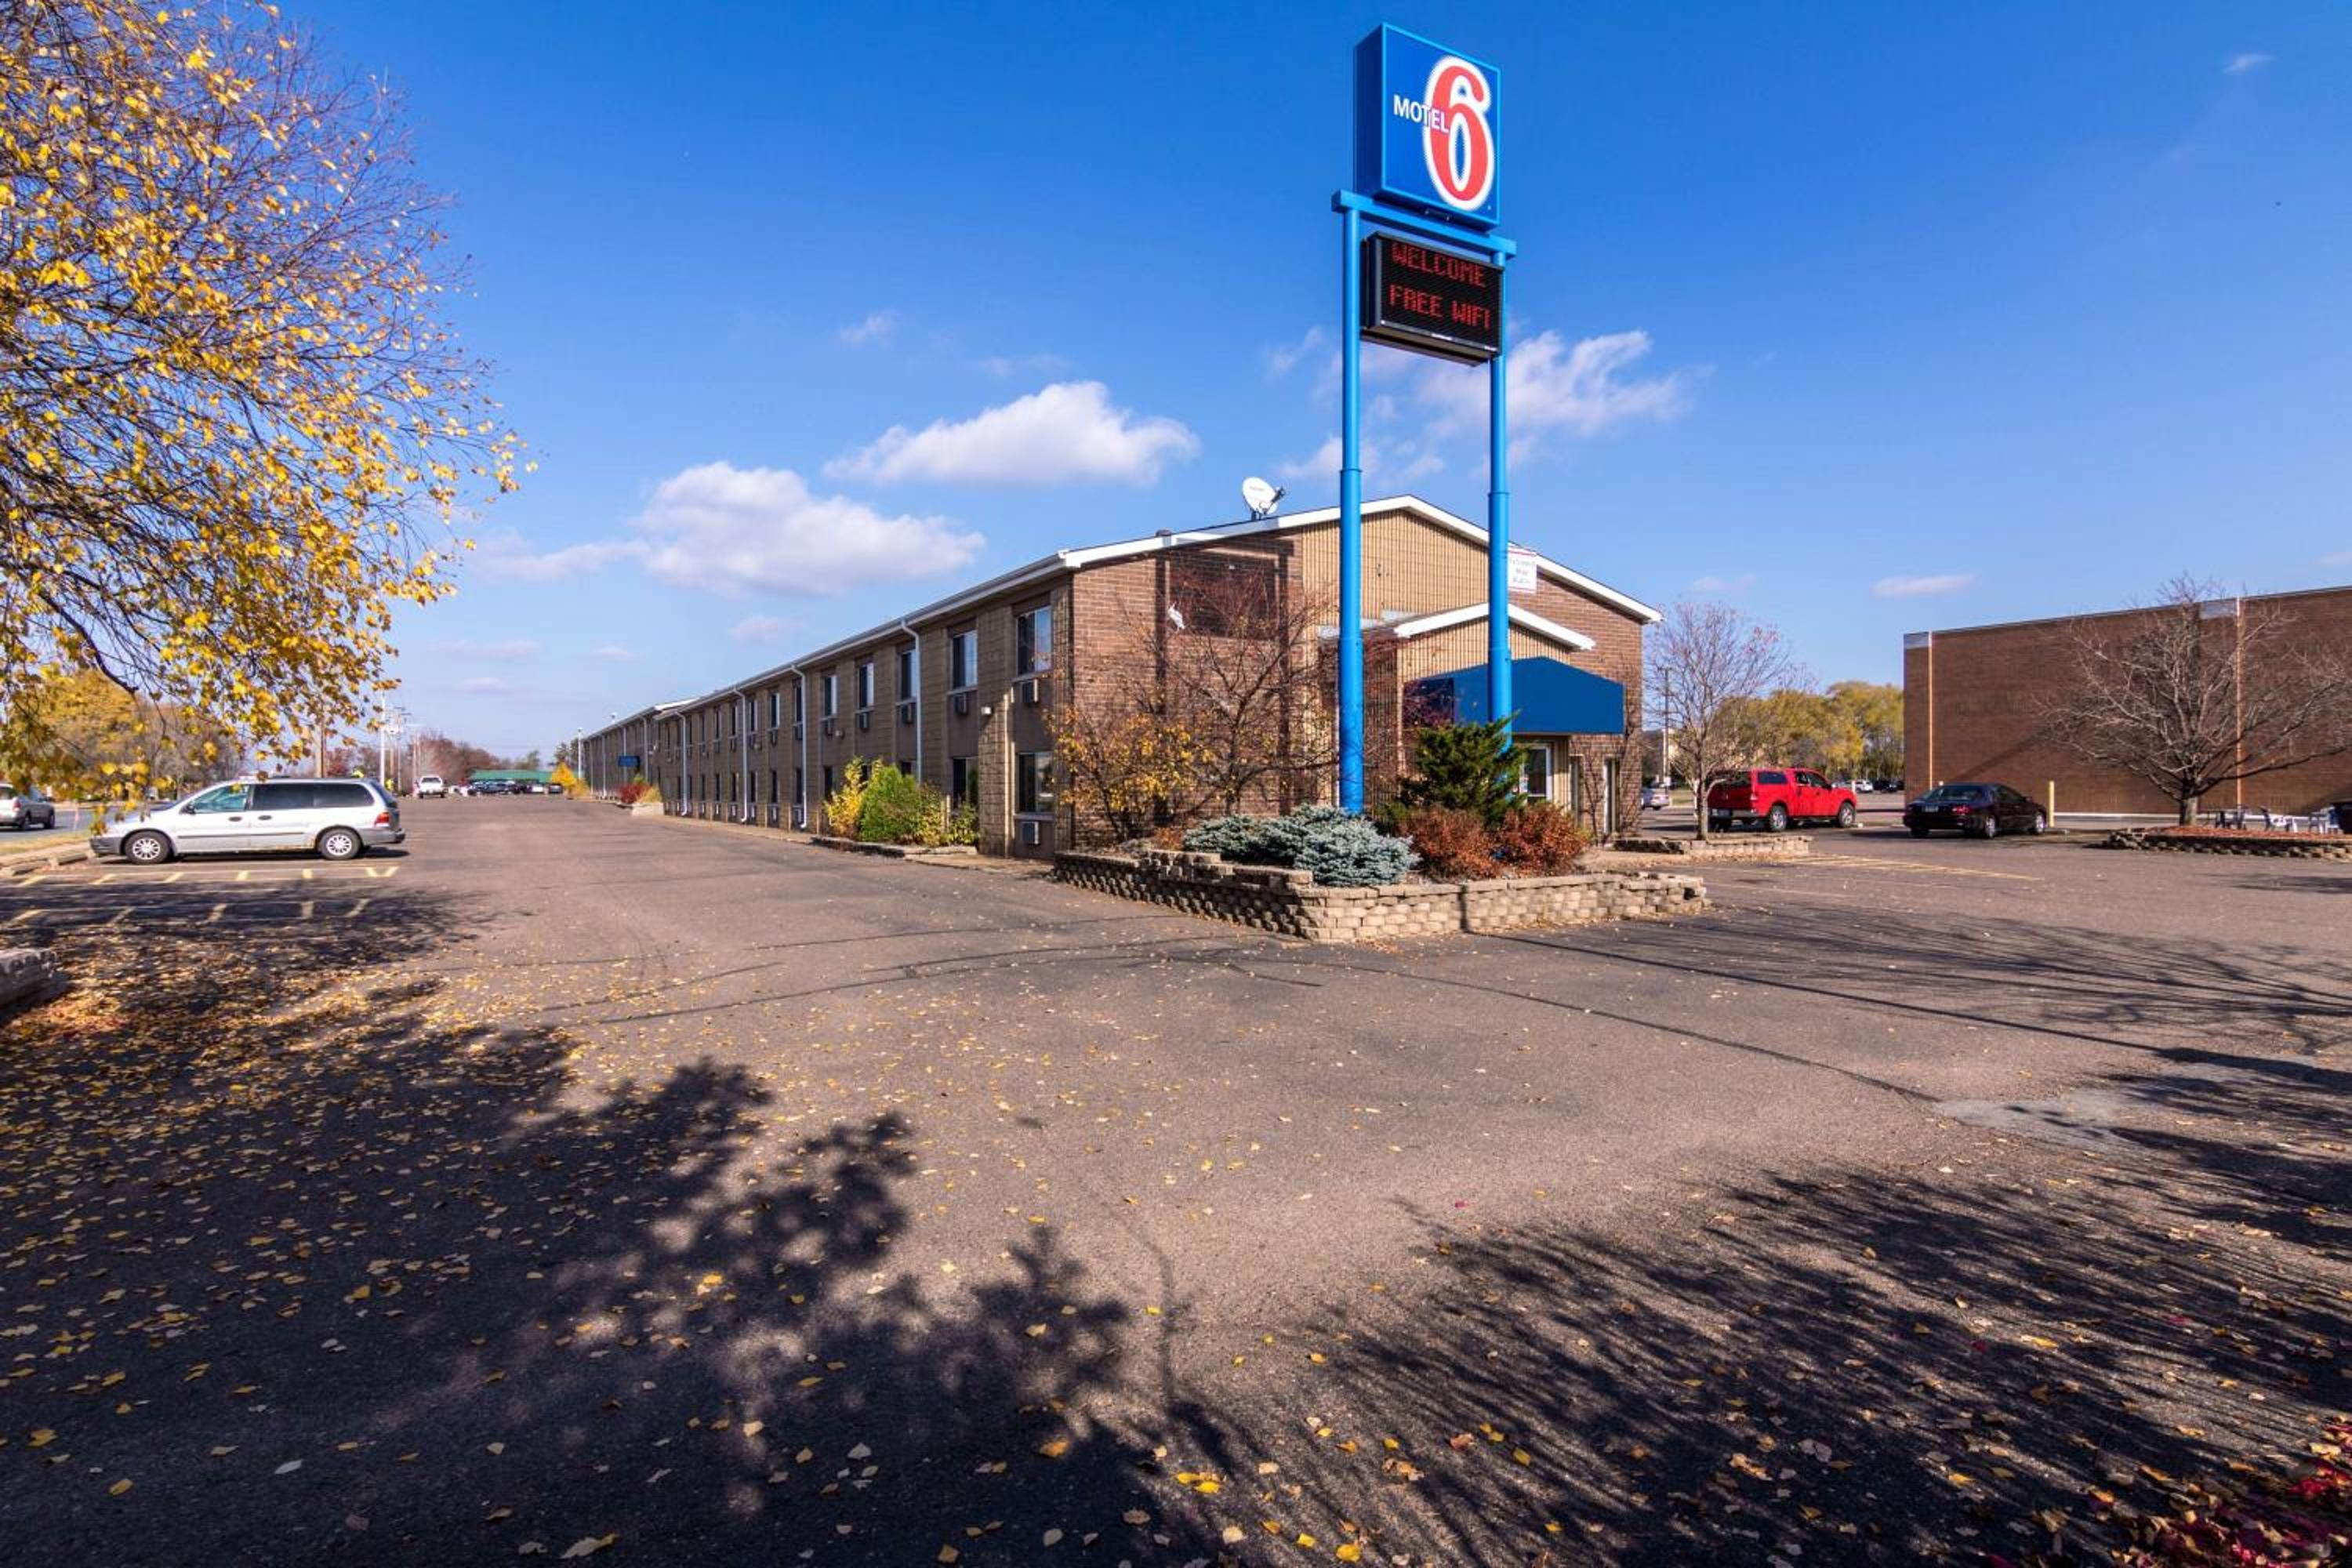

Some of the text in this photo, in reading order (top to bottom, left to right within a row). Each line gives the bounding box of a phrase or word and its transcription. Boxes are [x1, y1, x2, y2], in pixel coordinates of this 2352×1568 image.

[1393, 56, 1495, 210] MOTEL 6
[1392, 241, 1486, 288] WELCOME
[1389, 283, 1491, 329] FREE WIFI
